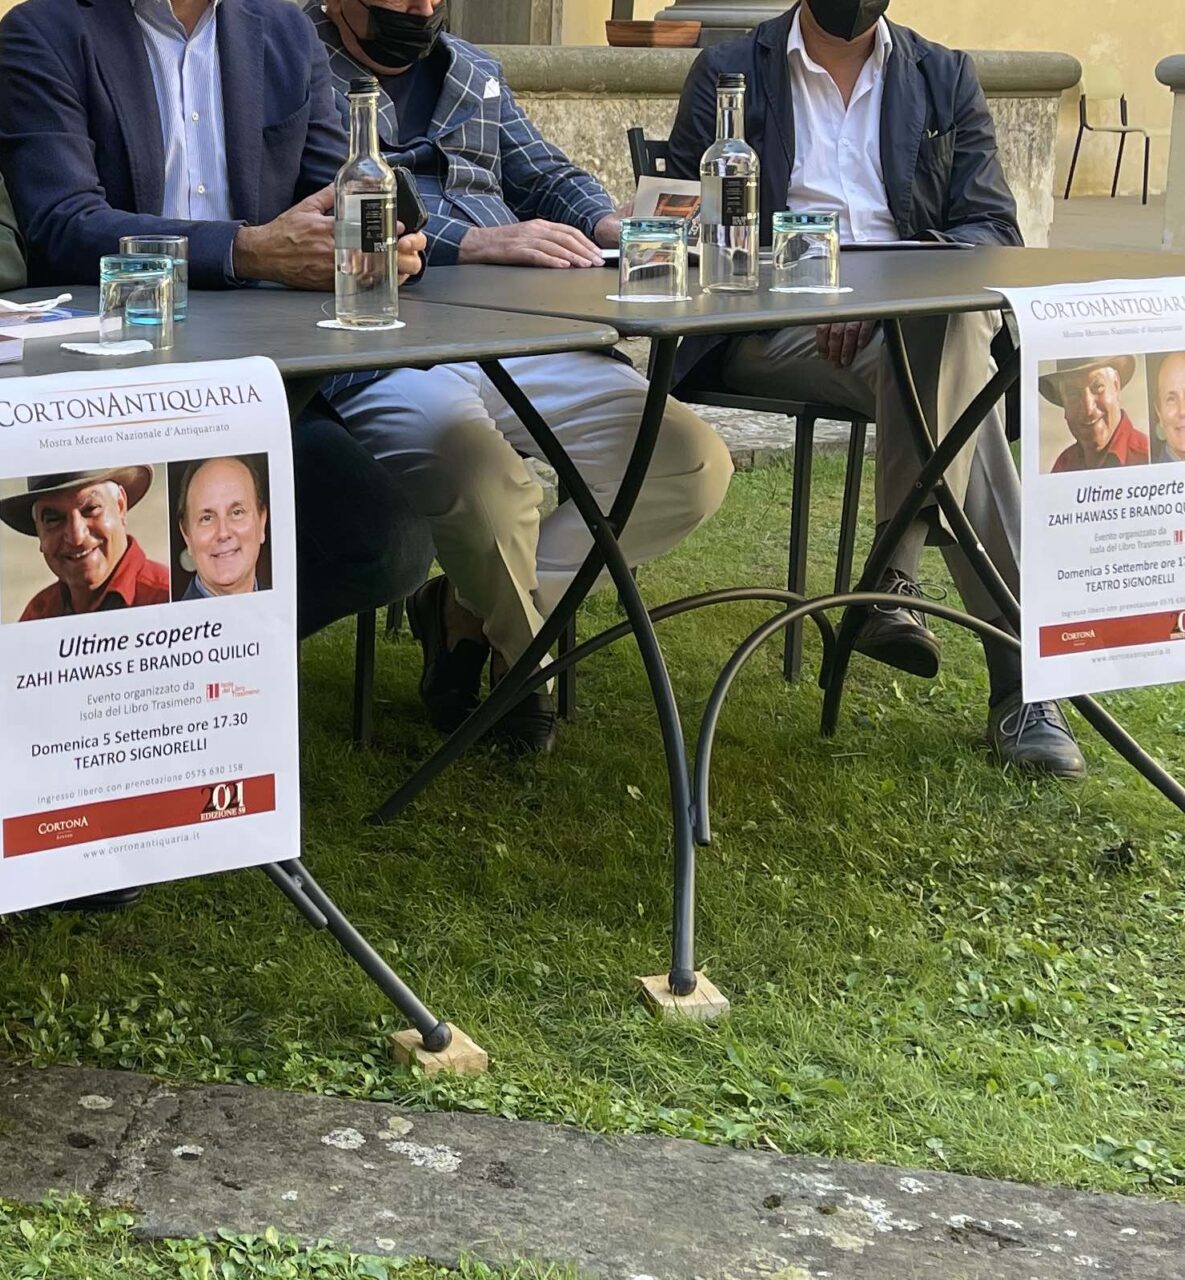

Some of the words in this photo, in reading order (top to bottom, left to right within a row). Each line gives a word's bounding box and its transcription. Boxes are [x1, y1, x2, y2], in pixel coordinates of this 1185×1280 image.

[39, 438, 72, 449] Mostra
[75, 433, 113, 445] Mercato
[116, 429, 162, 441] Nazionale
[164, 423, 230, 437] d'Antiquariato
[1076, 485, 1123, 503] Ultime
[1126, 480, 1184, 501] scoperte
[1048, 513, 1073, 526] ZAHI
[1075, 508, 1118, 524] HAWASS
[1121, 507, 1126, 519] E
[1129, 503, 1172, 518] BRANDO
[1057, 566, 1102, 580] Domenica
[1105, 564, 1110, 575] 5
[1112, 560, 1158, 574] Settembre
[1161, 560, 1176, 569] ore
[1086, 579, 1120, 593] TEATRO
[1123, 573, 1175, 589] SIGNORELLI
[59, 633, 129, 658] Ultime
[134, 621, 222, 648] scoperte
[16, 671, 53, 690] ZAHI
[58, 661, 122, 683] HAWASS
[127, 659, 135, 673] E
[140, 650, 203, 672] BRANDO
[208, 642, 260, 663] QUILICI
[87, 693, 121, 705] Evento
[124, 683, 180, 702] organizzato
[182, 681, 195, 691] da
[80, 708, 103, 721] Isola
[105, 705, 121, 718] del
[124, 700, 148, 715] Libro
[152, 695, 202, 711] Trasimeno
[31, 737, 98, 757] Domenica
[103, 733, 111, 746] 5
[115, 723, 183, 744] Settembre
[187, 720, 209, 733] ore
[212, 712, 248, 729] 17.30
[74, 750, 126, 770] TEATRO
[130, 738, 207, 762] SIGNORELLI
[77, 787, 104, 798] libero
[106, 783, 122, 792] con
[125, 775, 183, 791] prenotazione
[201, 781, 244, 812] 2021
[38, 816, 88, 834] CORTONA
[200, 808, 237, 821] EDIZIONE
